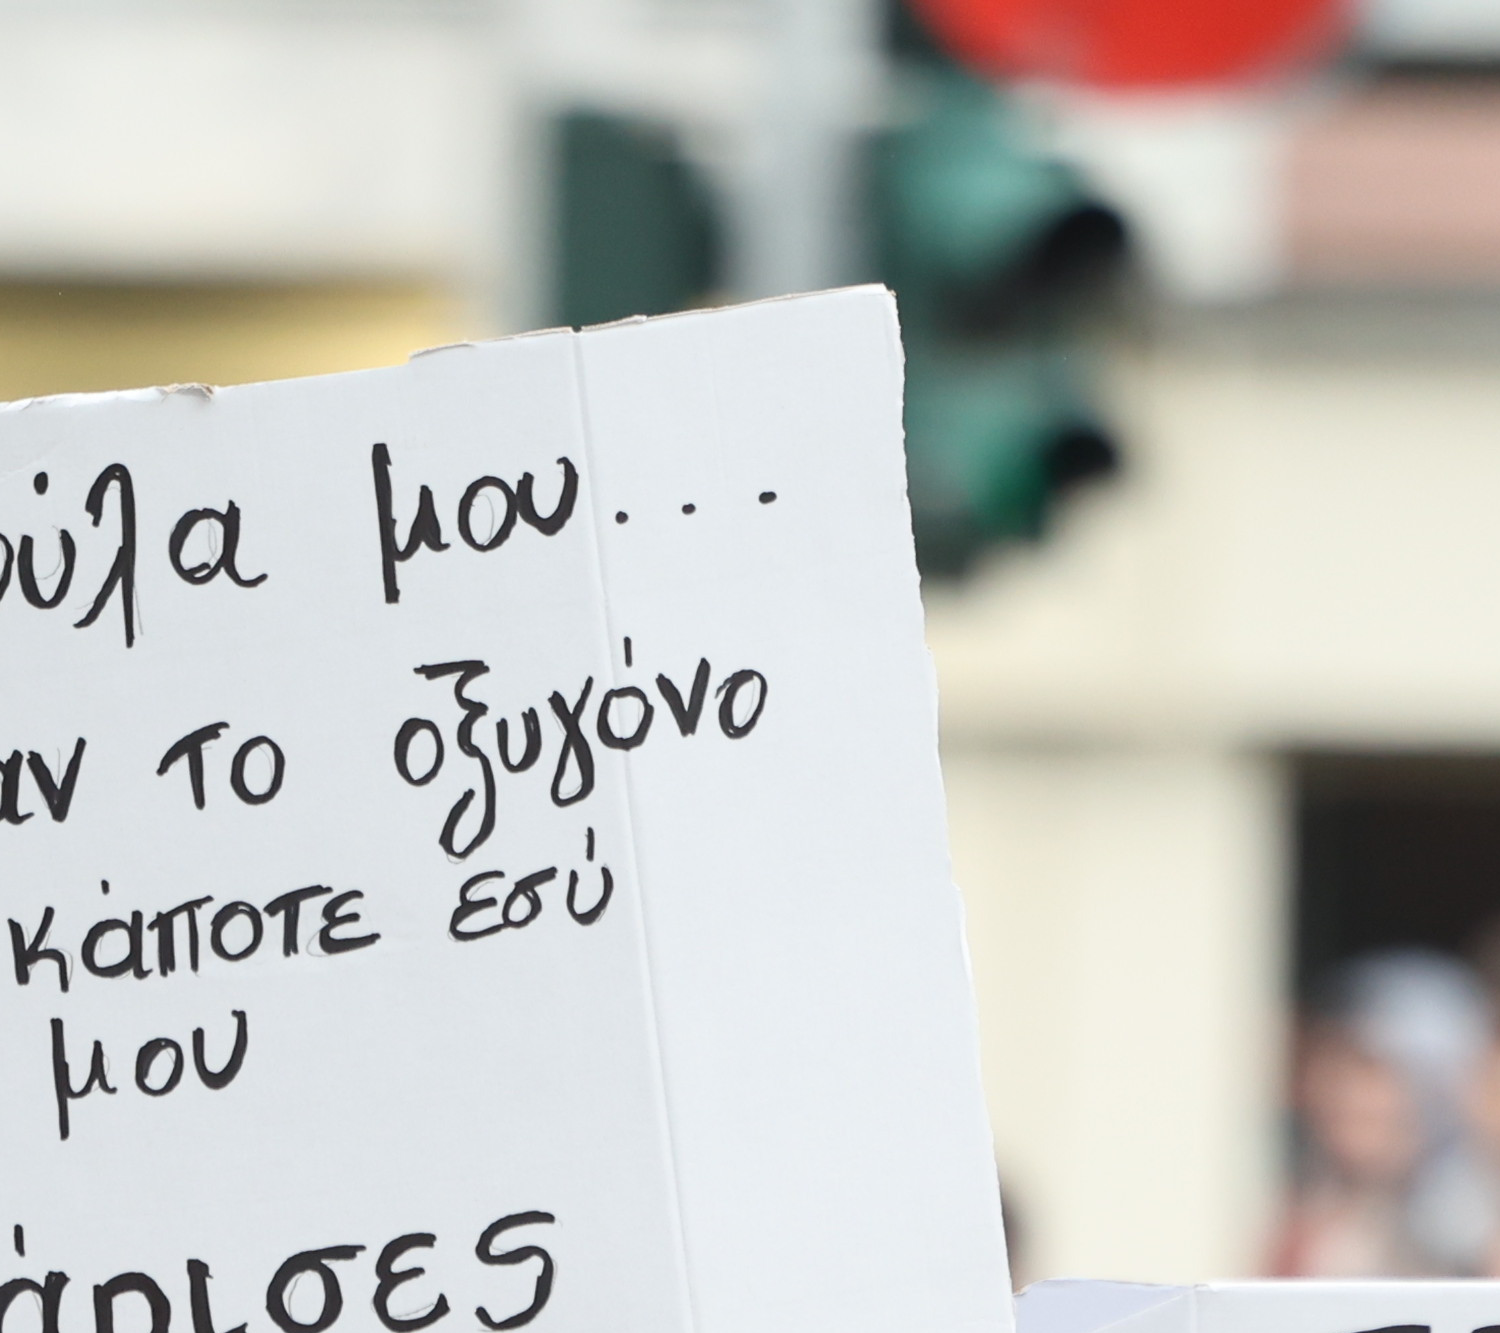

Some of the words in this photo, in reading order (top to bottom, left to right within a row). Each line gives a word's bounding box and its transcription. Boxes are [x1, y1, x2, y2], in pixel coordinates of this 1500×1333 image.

[156, 720, 287, 808] το
[394, 636, 768, 860] οξυγόνο
[8, 877, 383, 994] κάποτε
[448, 827, 614, 942] εσύ
[49, 1009, 250, 1141] μου
